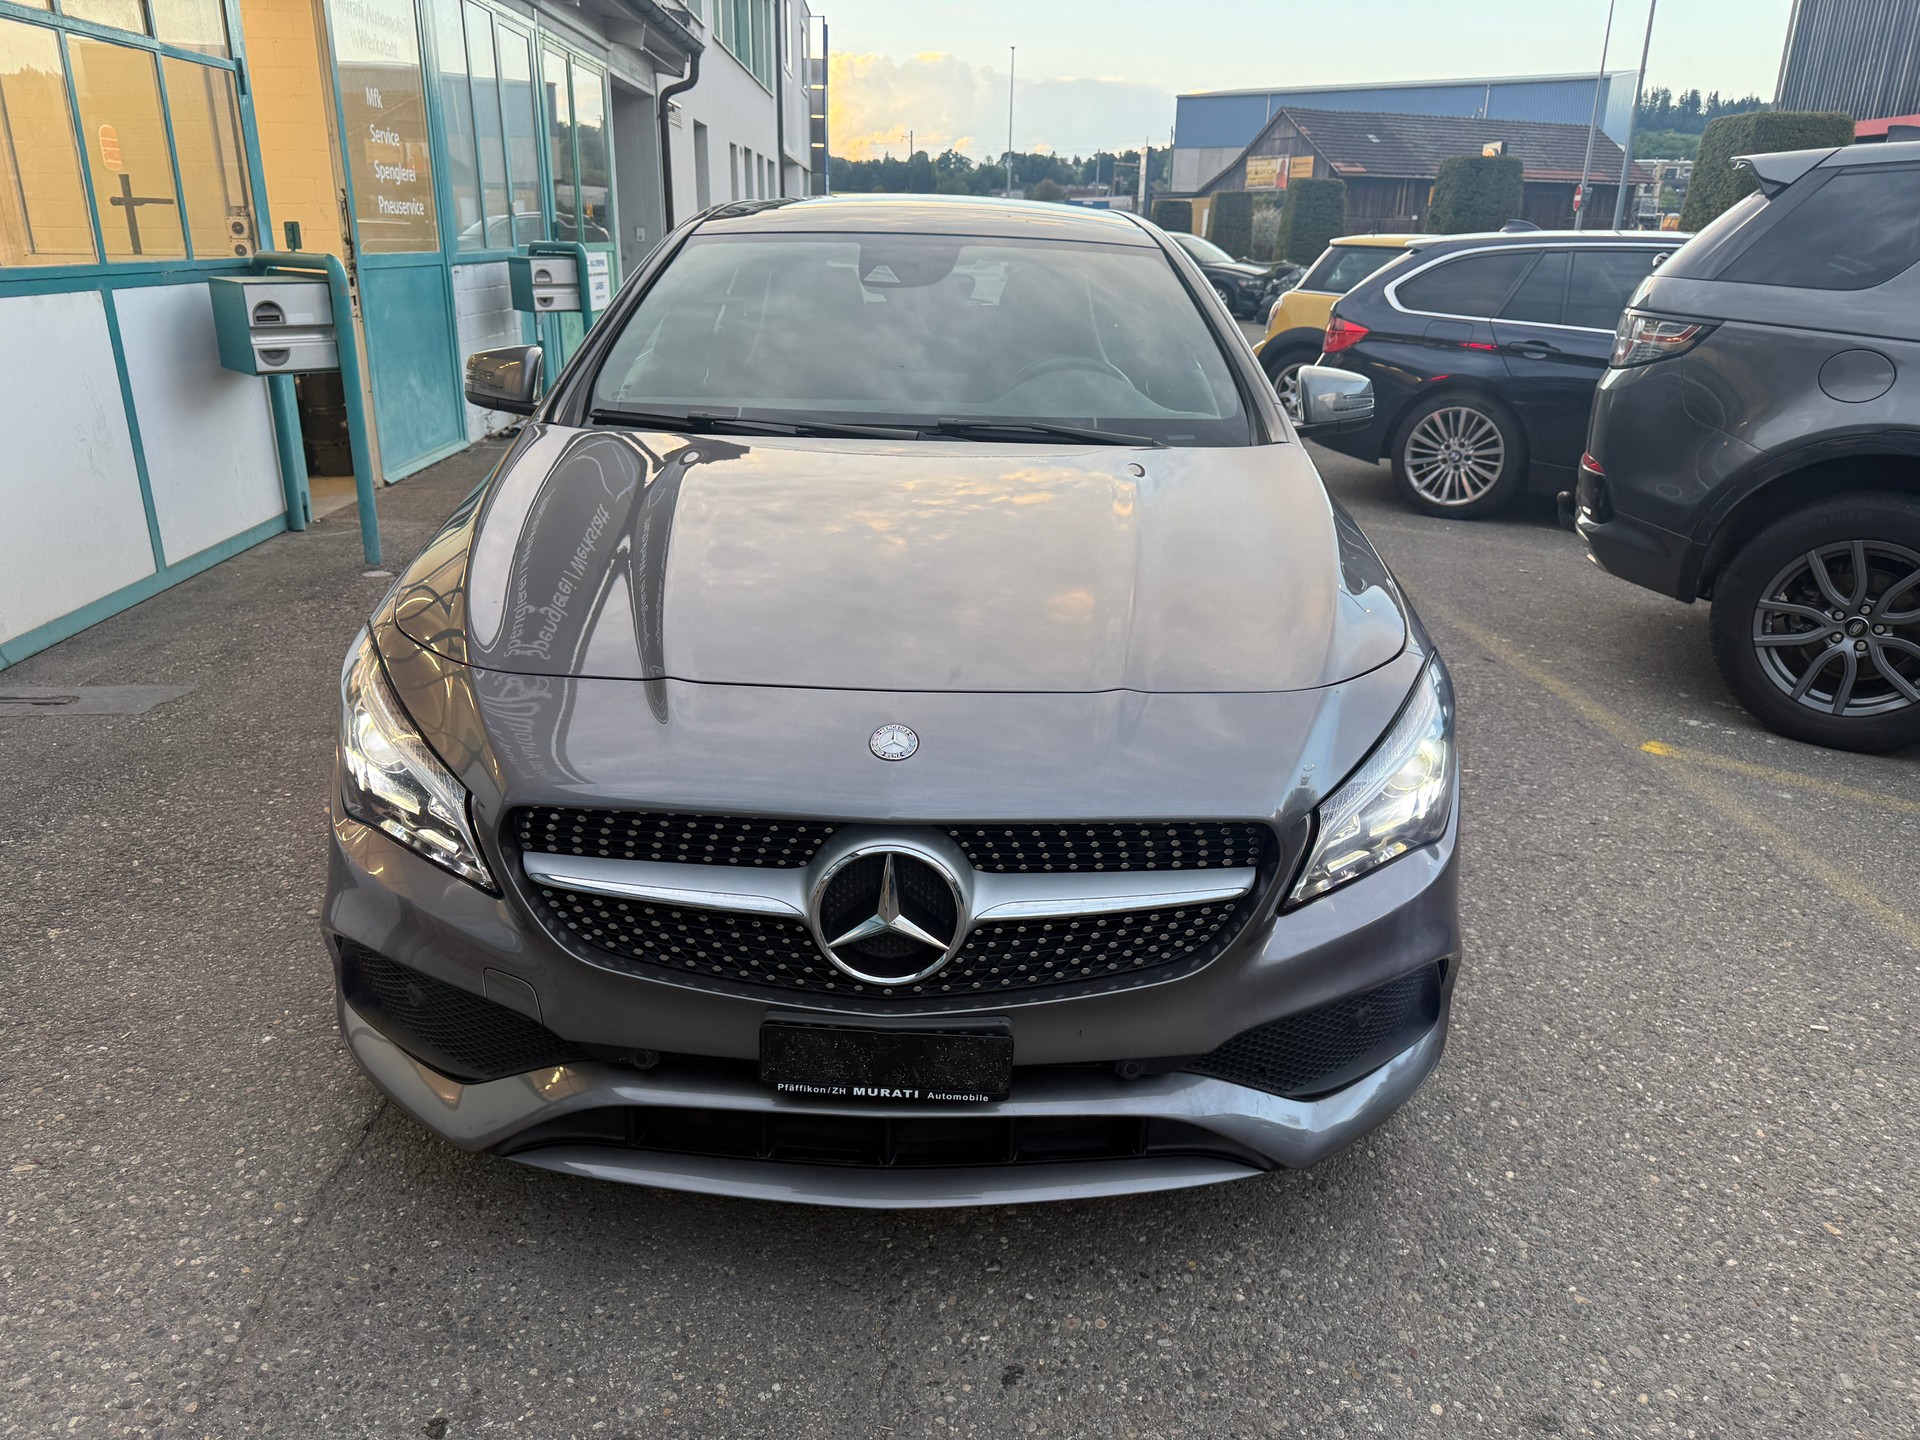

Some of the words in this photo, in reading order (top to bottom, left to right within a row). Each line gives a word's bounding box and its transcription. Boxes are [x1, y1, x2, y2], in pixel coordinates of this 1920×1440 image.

[366, 86, 383, 109] Mfk
[369, 124, 400, 147] Service
[373, 160, 416, 186] Spenglerei
[378, 195, 425, 216] Pneuservice
[777, 1083, 846, 1096] Pfäffikon/ZH
[852, 1087, 919, 1099] MURATI
[927, 1091, 989, 1102] Automobile
